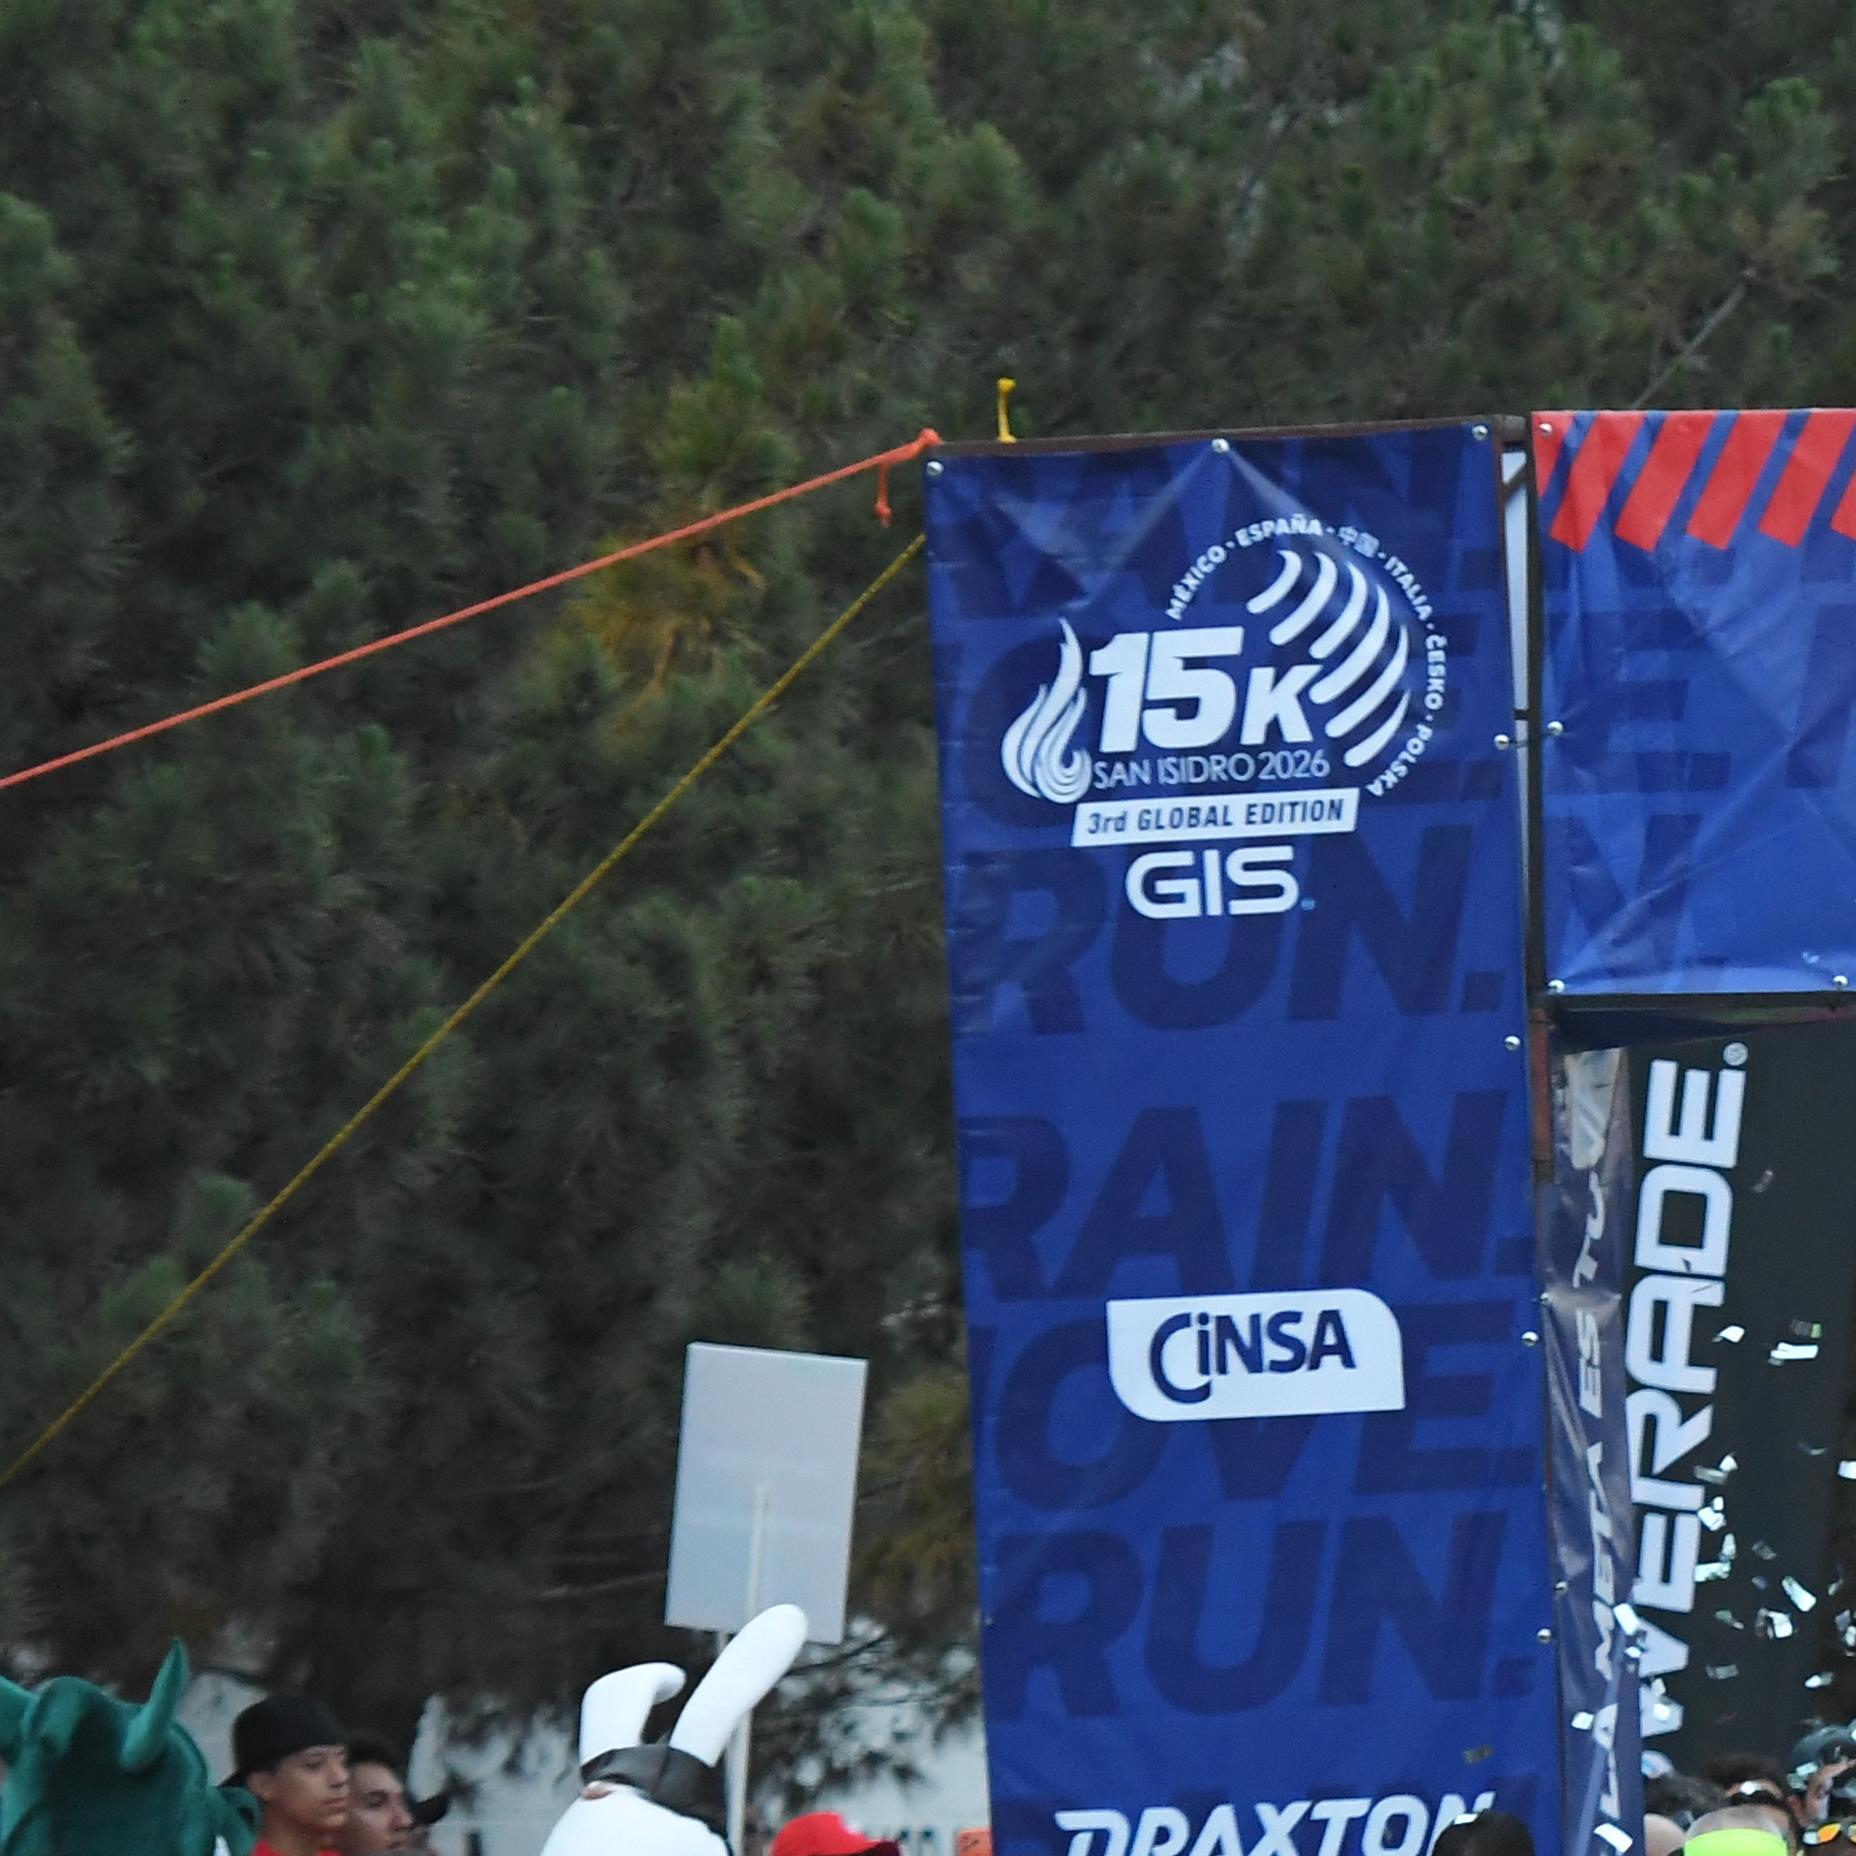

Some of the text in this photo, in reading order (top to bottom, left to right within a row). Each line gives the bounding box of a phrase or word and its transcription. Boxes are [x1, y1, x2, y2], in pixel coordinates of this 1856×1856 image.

[1233, 514, 1322, 549] ESPAÑA
[1166, 545, 1226, 620] MÉXICO
[1384, 556, 1431, 621] ITALIA
[1089, 627, 1324, 753] 15K
[1094, 750, 1329, 789] SAN ISIDRO 2026
[1366, 725, 1431, 797] POLSKA
[1087, 798, 1342, 835] 3rd GLOBAL EDITION
[1125, 846, 1300, 918] GIS
